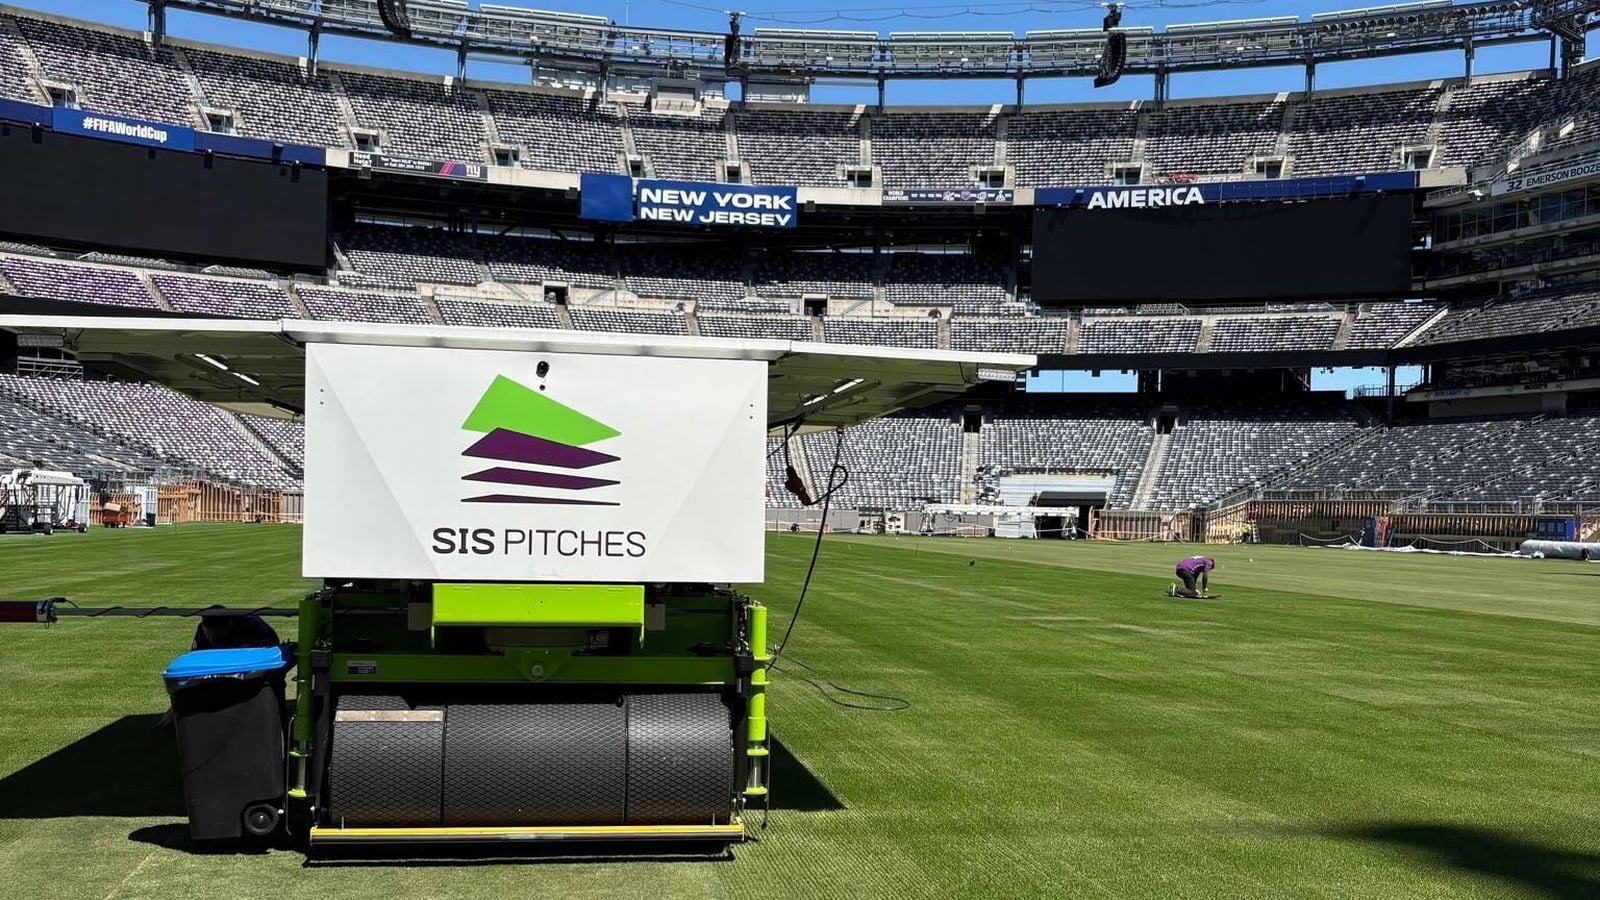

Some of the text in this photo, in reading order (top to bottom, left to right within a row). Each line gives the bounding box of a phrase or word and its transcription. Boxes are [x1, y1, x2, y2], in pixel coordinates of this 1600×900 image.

[83, 117, 167, 143] #FIFAWorldCup
[1506, 180, 1522, 192] 32
[1526, 170, 1569, 187] EMERSON
[641, 188, 792, 210] NEW YORK
[1087, 186, 1205, 210] AMERICA
[641, 207, 792, 226] NEW JERSEY
[432, 527, 646, 557] SIS PITCHES
